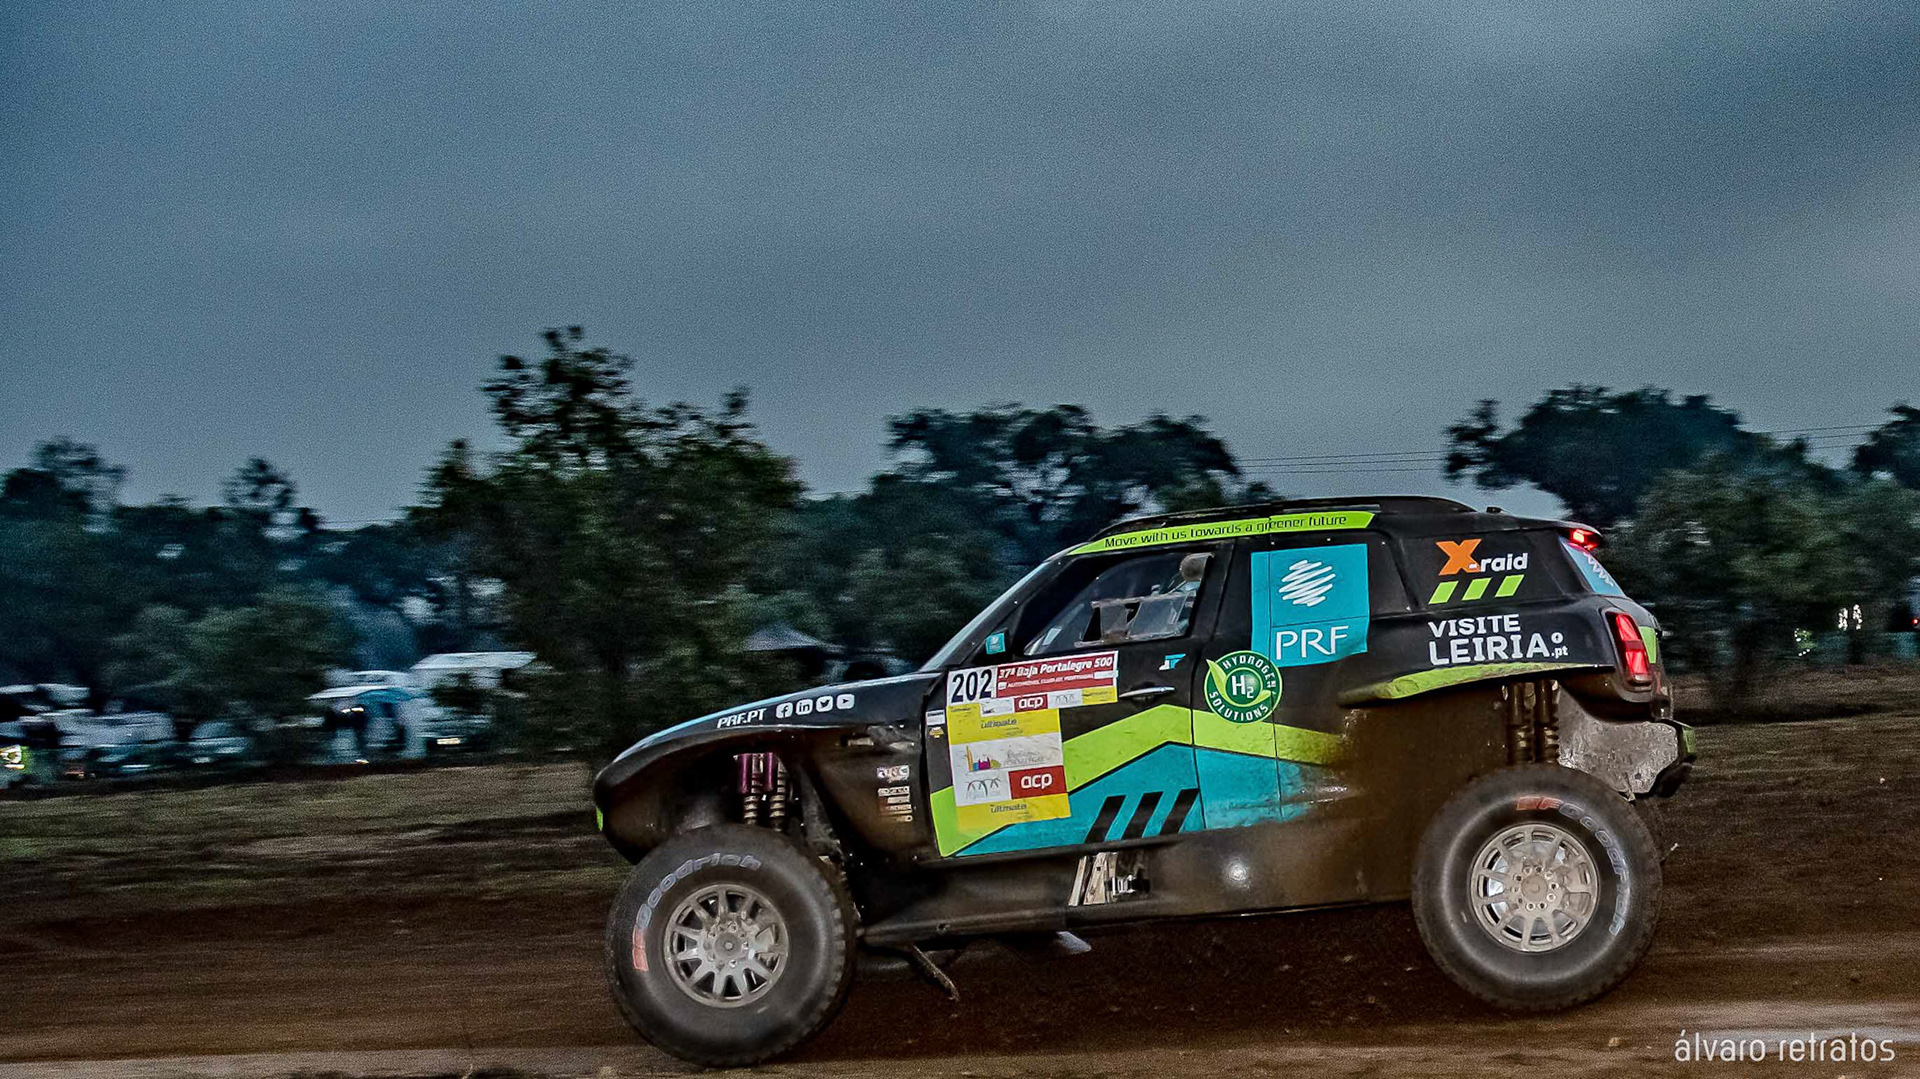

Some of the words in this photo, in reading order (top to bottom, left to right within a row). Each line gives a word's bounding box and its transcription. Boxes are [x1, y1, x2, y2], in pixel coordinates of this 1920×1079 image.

[1104, 537, 1138, 548] Move
[1141, 532, 1168, 543] with
[1172, 531, 1187, 539] us
[1190, 524, 1242, 538] towards
[1243, 523, 1253, 532] a
[1256, 518, 1304, 533] greener
[1309, 514, 1347, 527] future
[1428, 613, 1521, 638] VISITE
[1275, 625, 1349, 660] PRF
[1016, 666, 1038, 679] Baja
[1039, 660, 1092, 675] Portalegre
[1094, 656, 1113, 668] 500
[1222, 655, 1276, 688] HYDROGEN
[951, 668, 993, 704] 202
[1018, 697, 1044, 709] acp
[1209, 691, 1269, 721] SOLUTIONS
[716, 708, 767, 728] PRF.PT
[1021, 773, 1053, 790] acp
